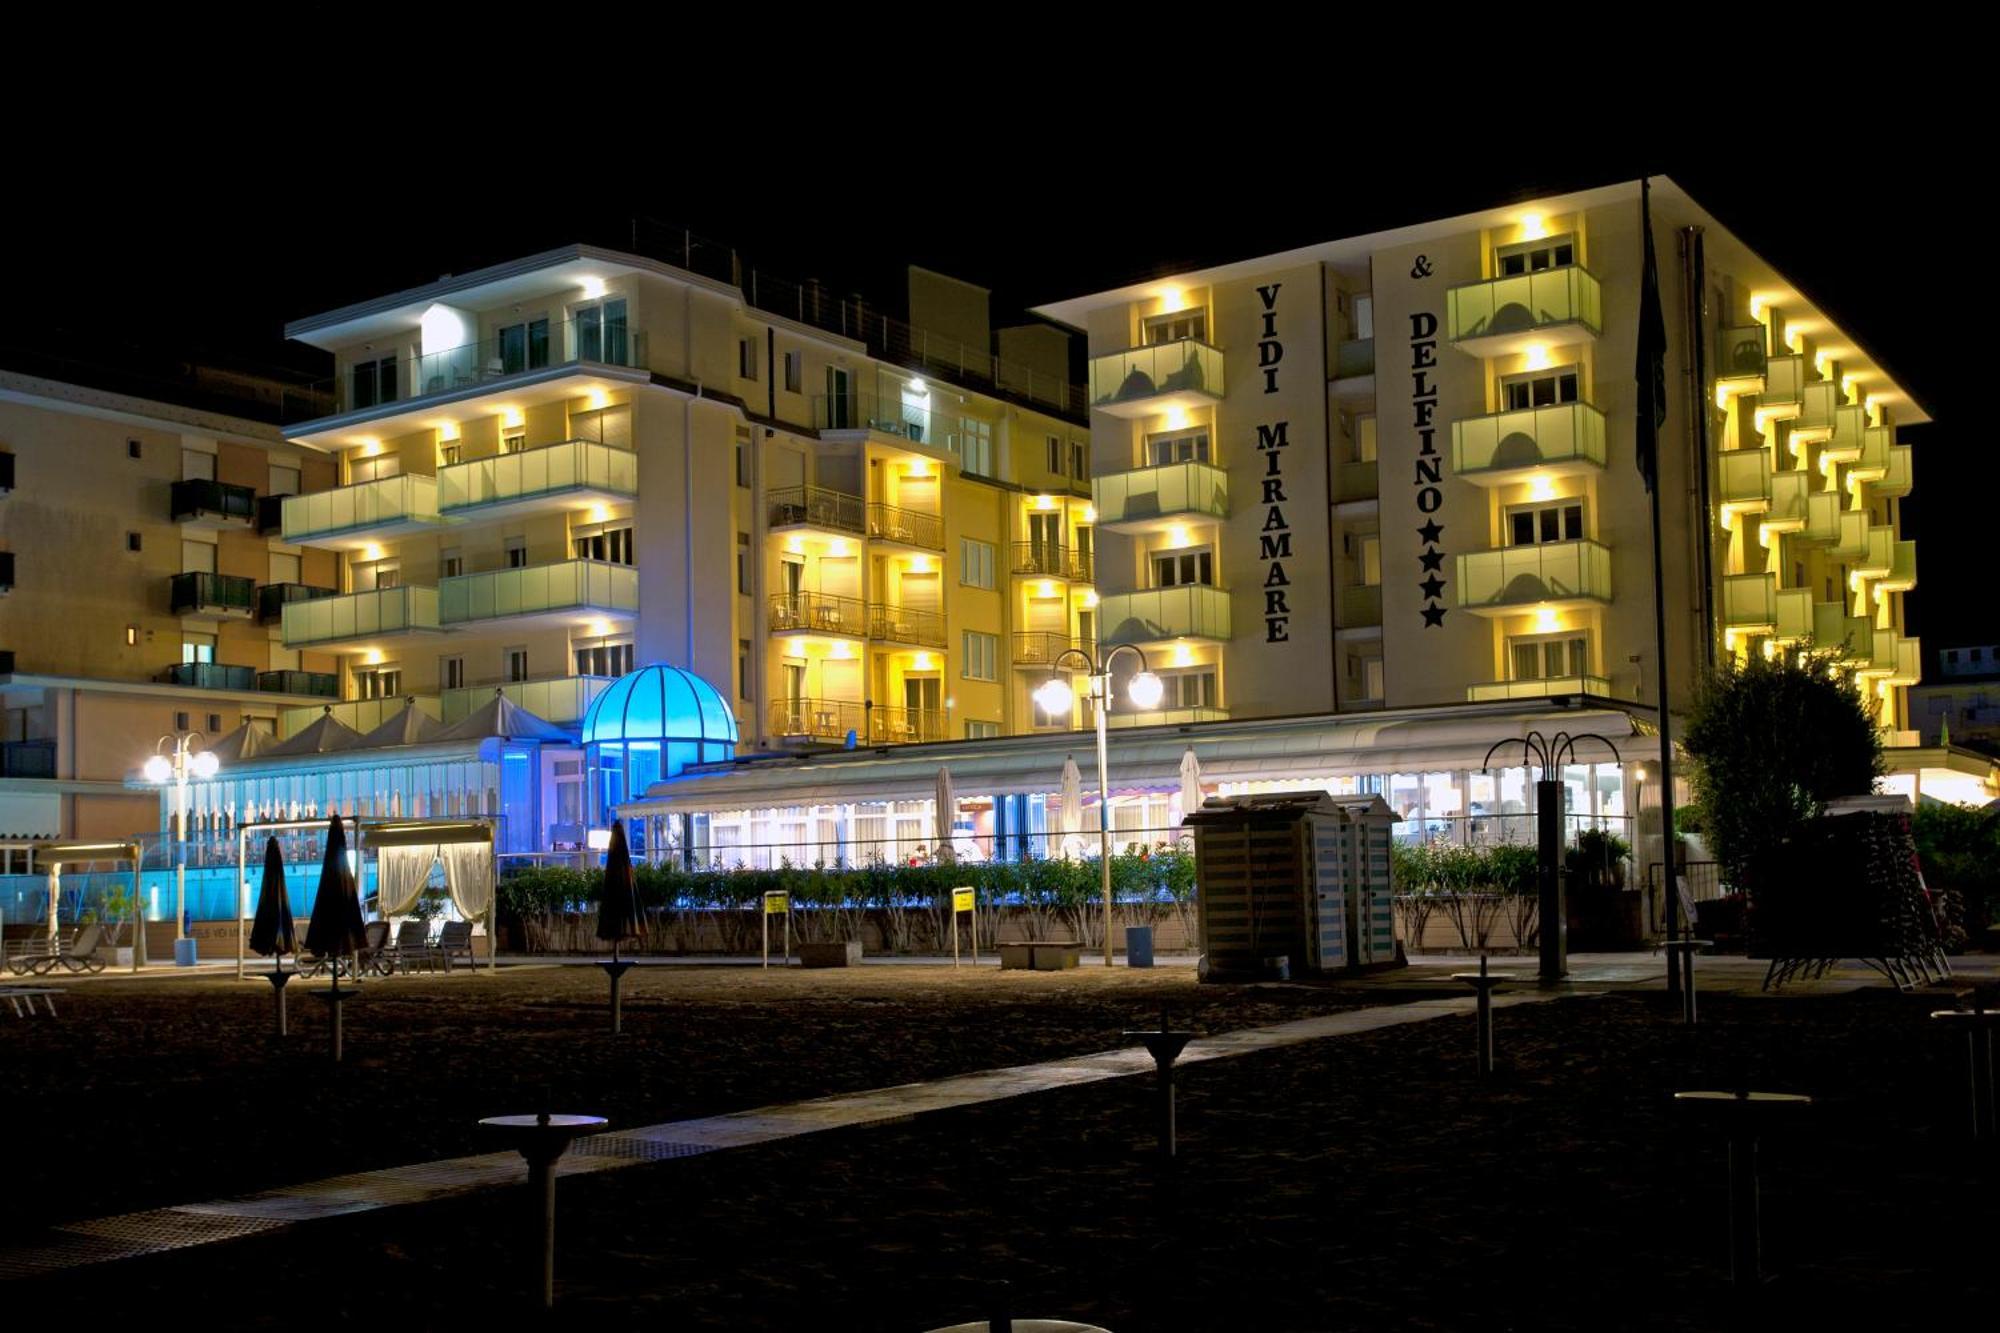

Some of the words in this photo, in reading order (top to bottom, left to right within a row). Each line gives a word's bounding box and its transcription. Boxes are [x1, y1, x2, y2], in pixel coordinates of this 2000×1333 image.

[1256, 284, 1283, 394] VIDI
[1411, 255, 1432, 279] &
[1410, 313, 1442, 513] DELFINO
[1257, 422, 1292, 643] MIRAMARE
